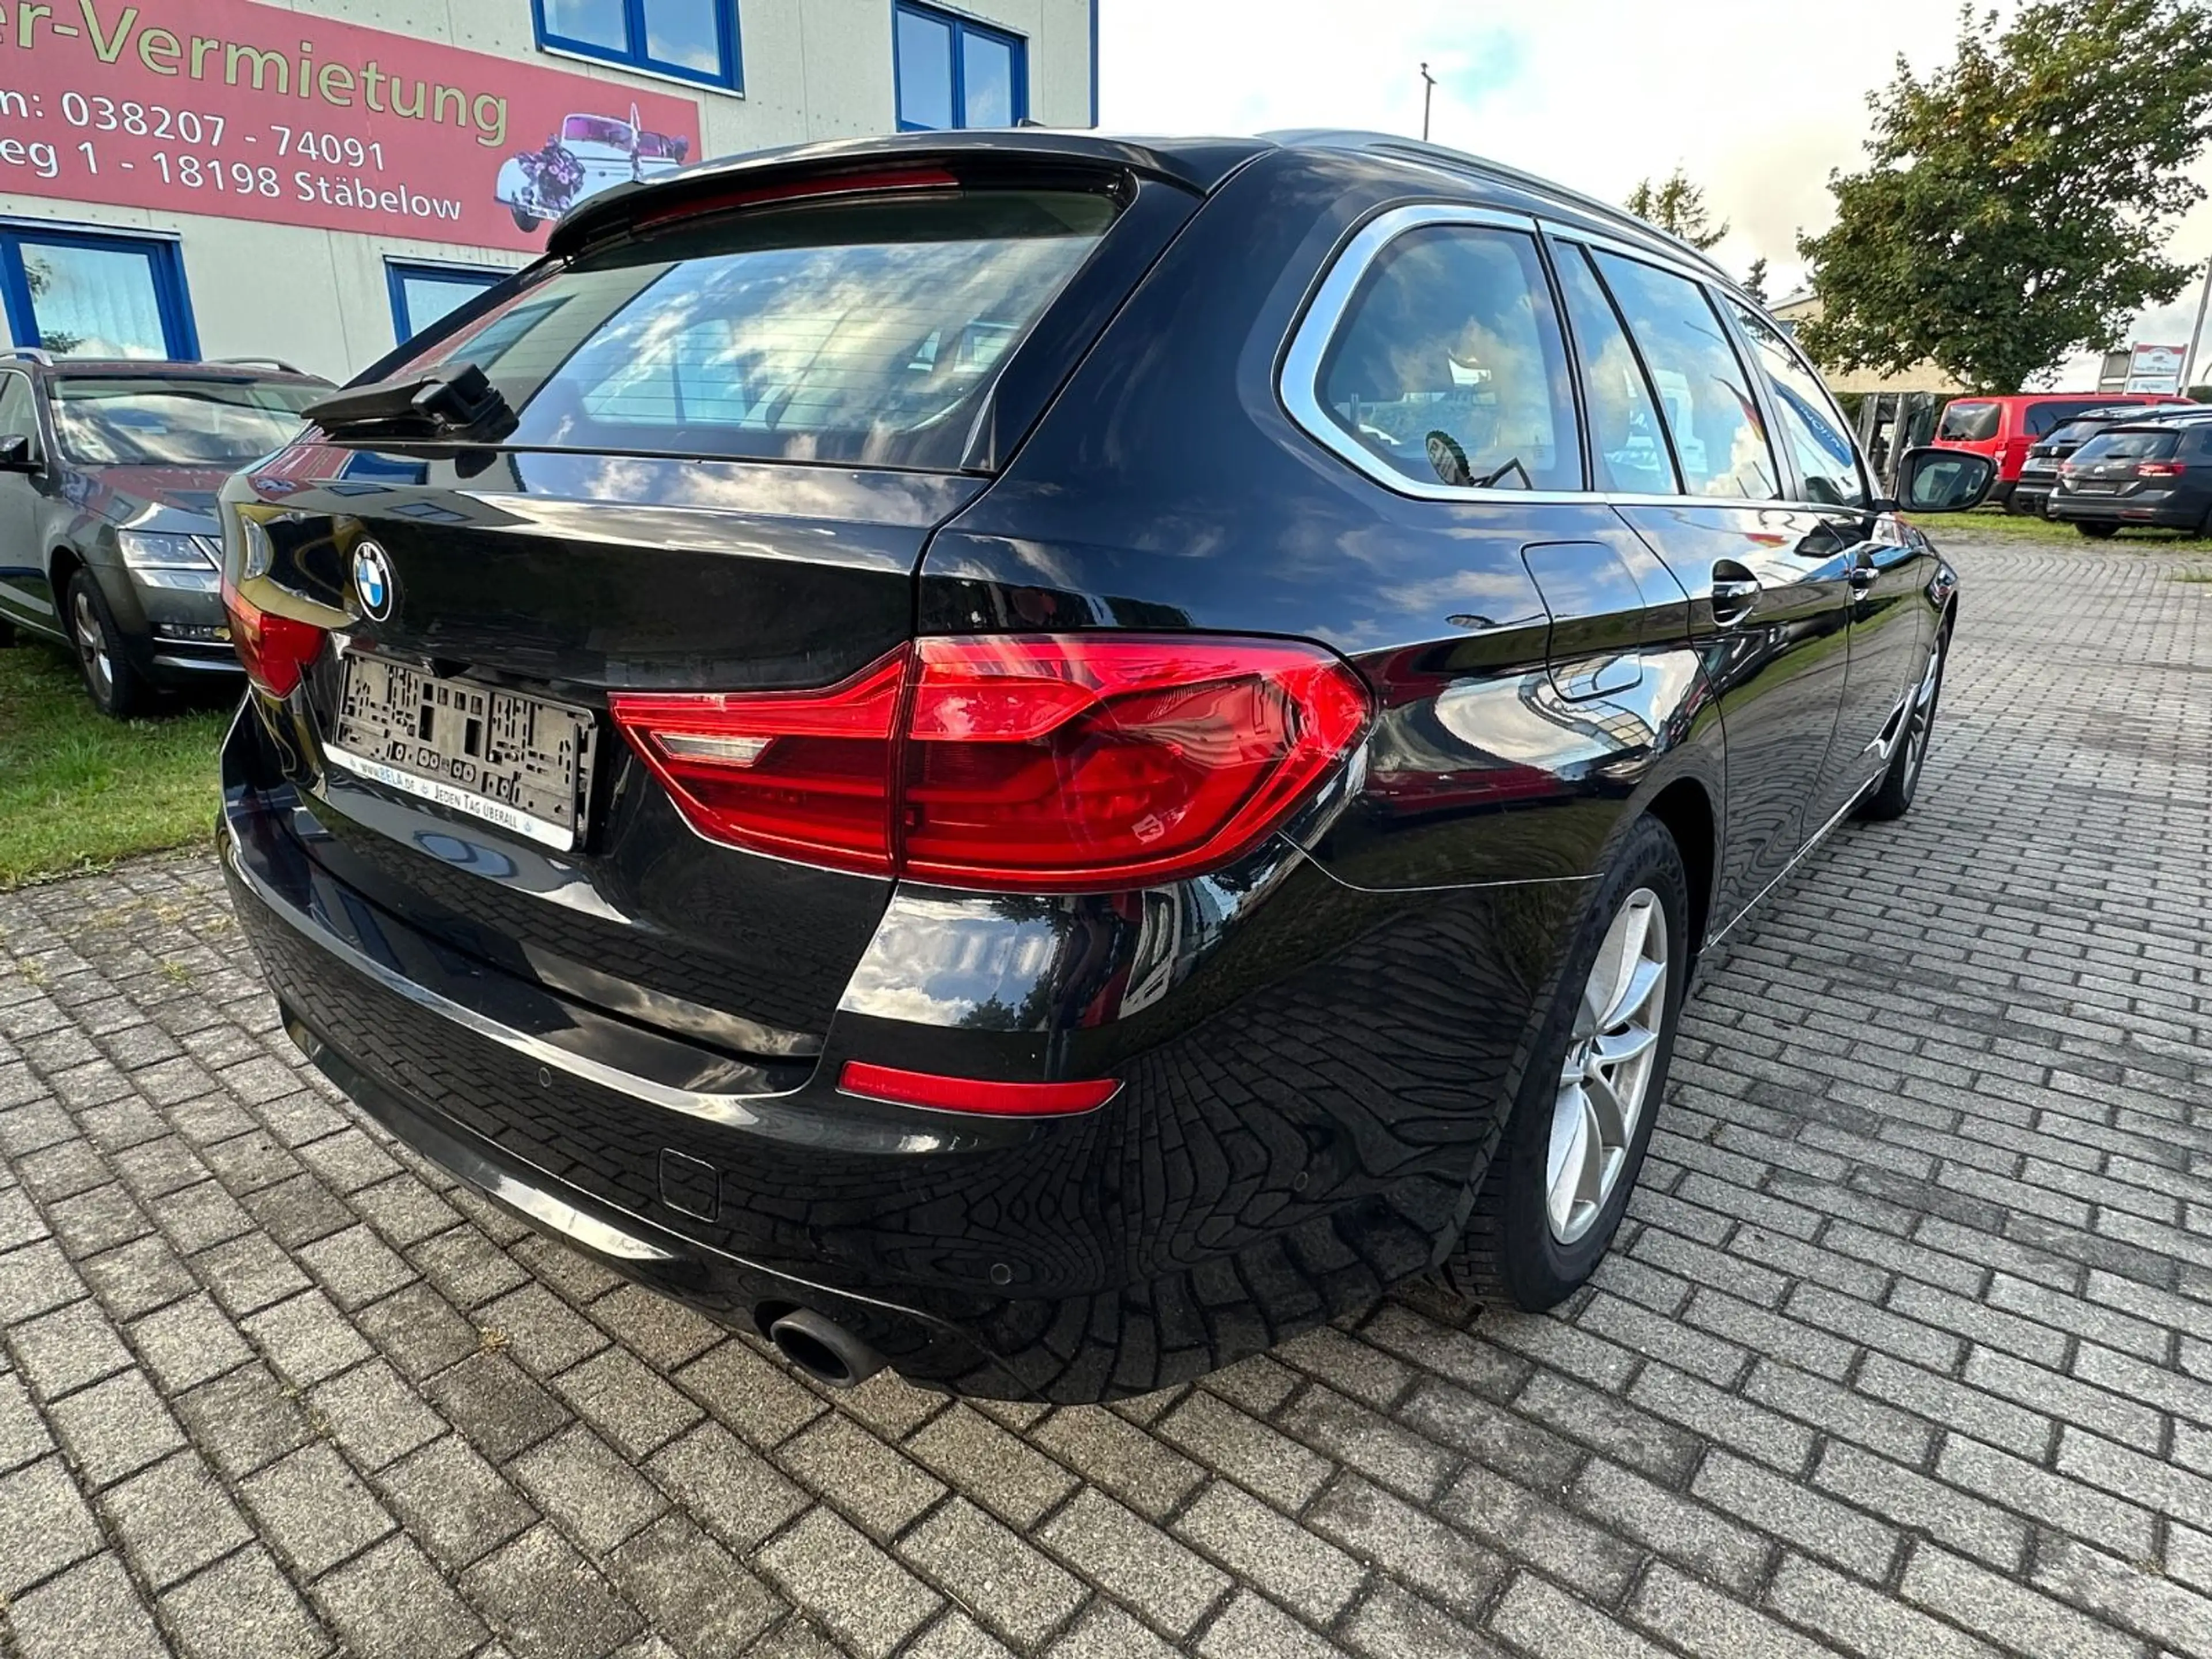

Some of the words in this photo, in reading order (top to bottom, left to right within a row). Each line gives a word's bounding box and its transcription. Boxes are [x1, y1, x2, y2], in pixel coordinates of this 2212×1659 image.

[0, 0, 507, 147] r-Vermietung
[62, 90, 225, 146] 038207
[270, 125, 384, 171] 74091
[78, 142, 98, 175] 1
[152, 152, 281, 198] 18198
[294, 172, 461, 220] Stäbelow
